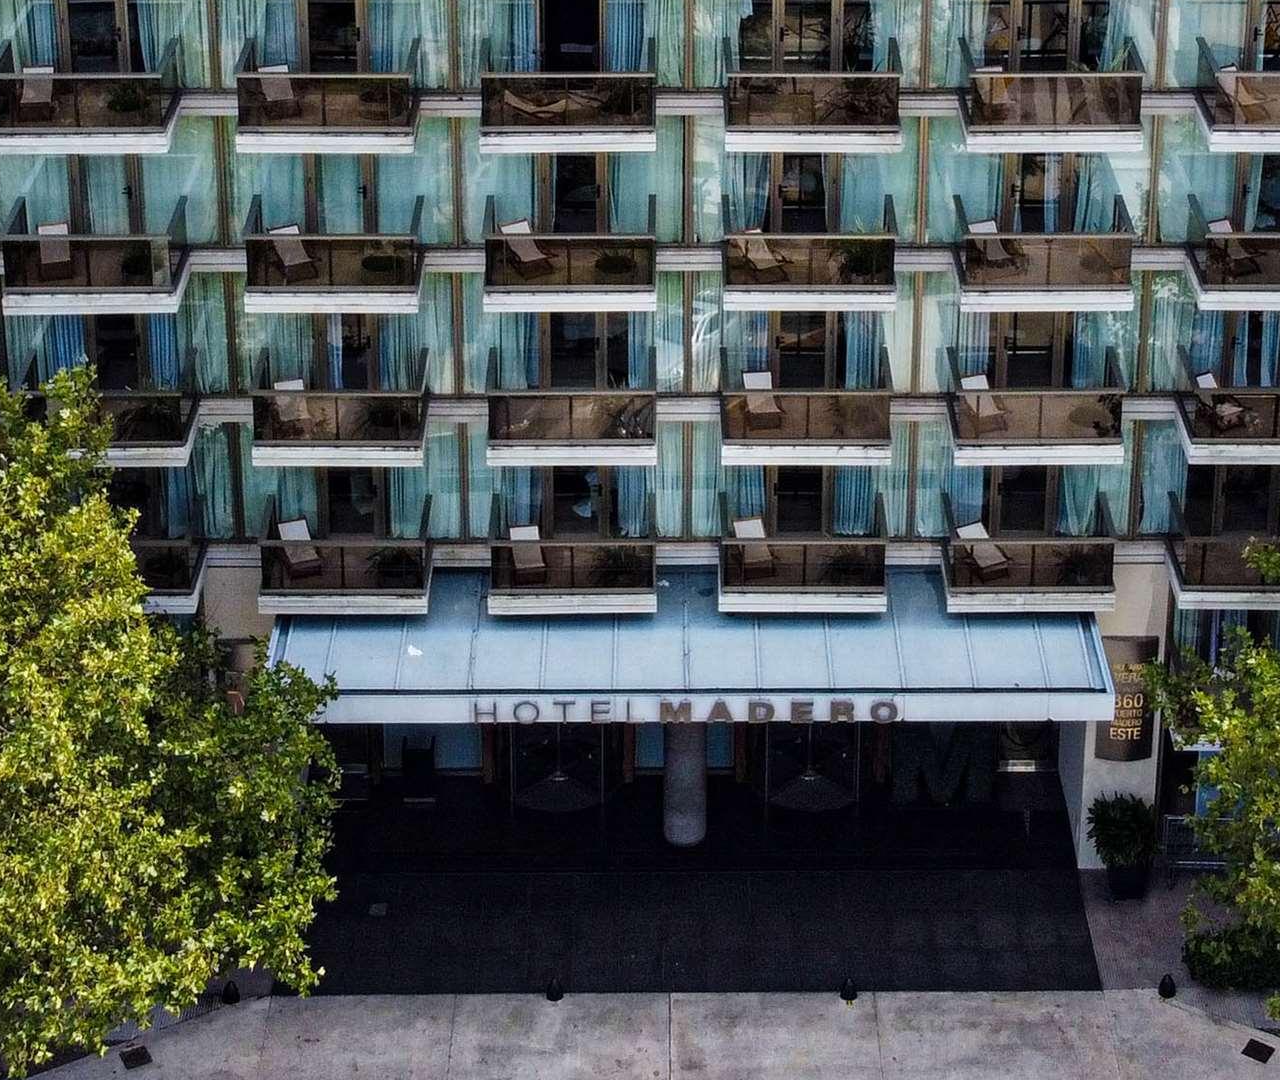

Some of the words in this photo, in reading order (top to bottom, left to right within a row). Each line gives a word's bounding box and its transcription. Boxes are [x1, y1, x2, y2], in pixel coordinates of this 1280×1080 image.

[474, 700, 646, 724] HOTEL
[660, 699, 898, 723] MADERO
[1110, 727, 1141, 740] ESTE
